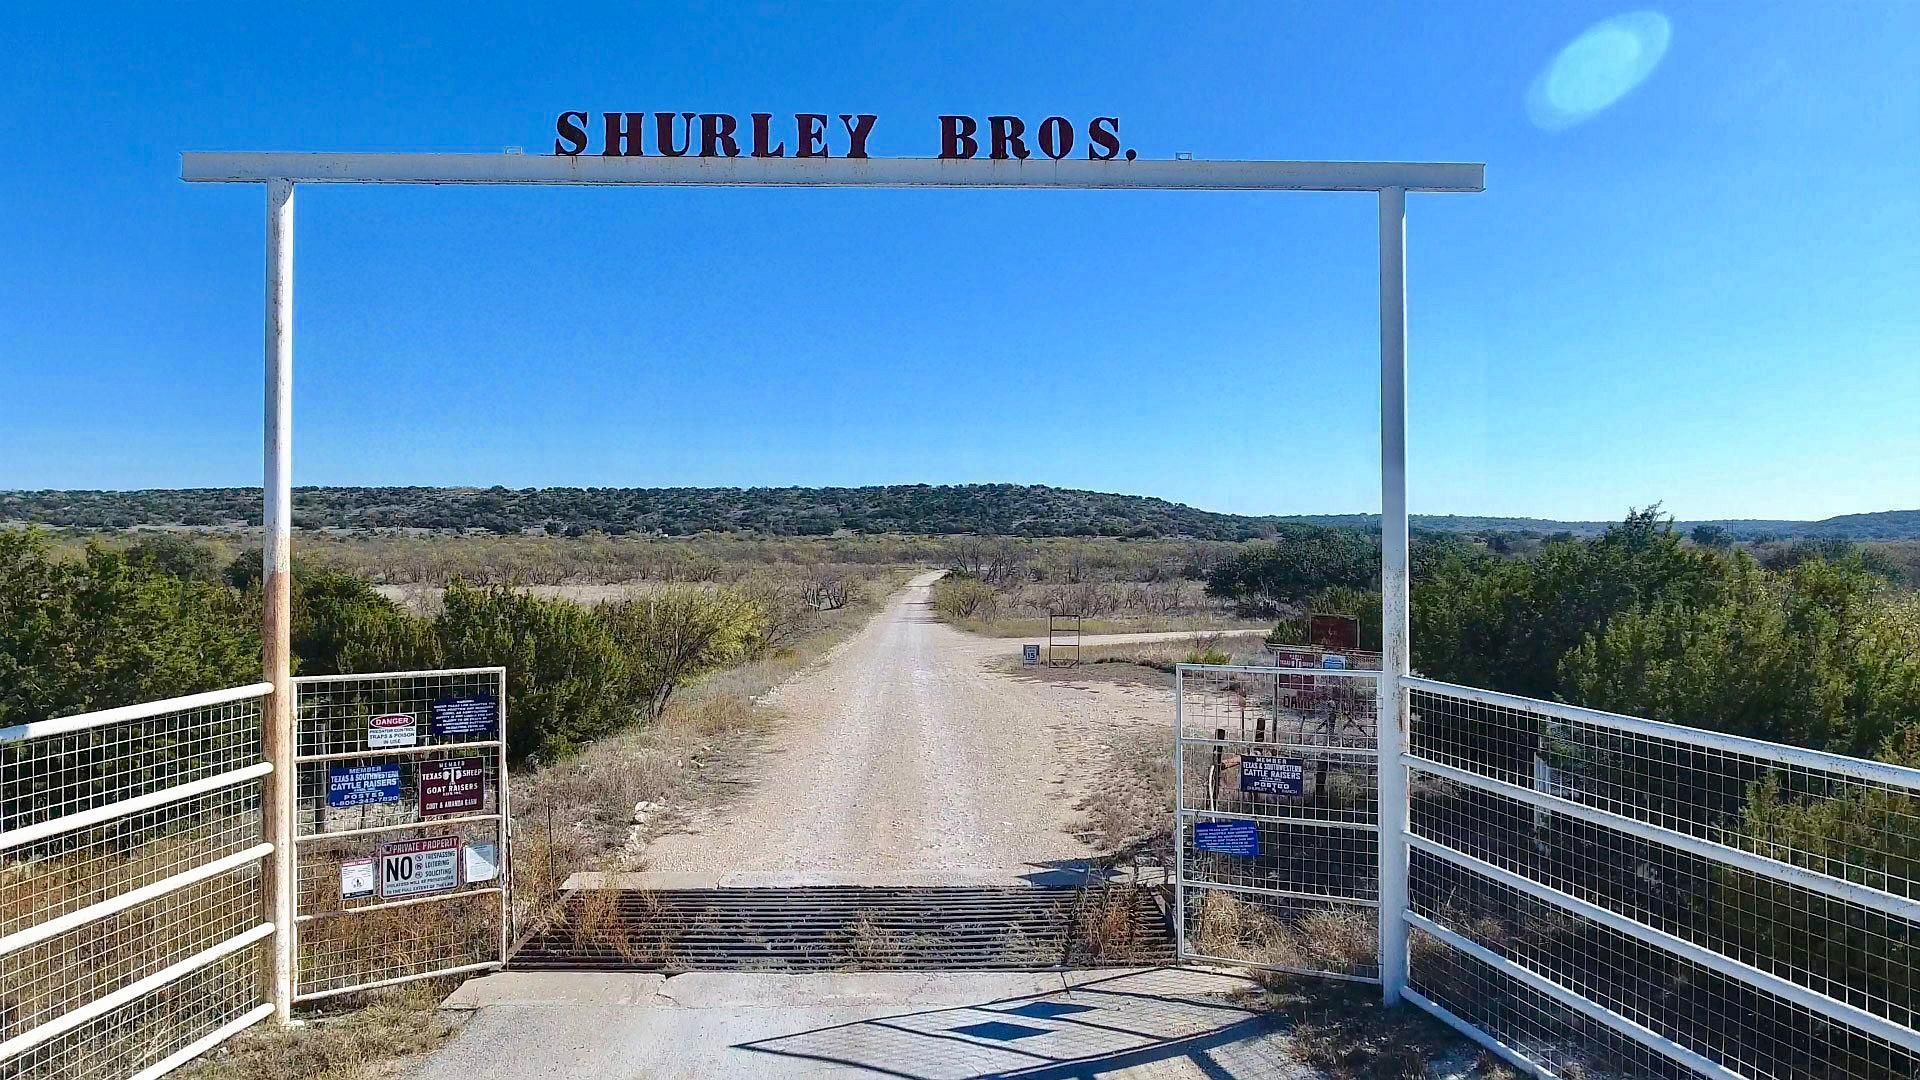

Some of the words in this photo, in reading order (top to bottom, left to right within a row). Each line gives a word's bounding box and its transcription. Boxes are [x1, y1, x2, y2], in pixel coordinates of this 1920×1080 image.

[555, 110, 878, 158] SHURLEY
[938, 115, 1137, 161] BROS.
[375, 717, 409, 726] DANGER
[1242, 761, 1258, 769] TEXAS
[1256, 757, 1287, 765] MEMBER
[349, 766, 382, 774] MEMBER
[422, 772, 442, 780] TEXAS
[462, 769, 482, 777] SHEEP
[1244, 769, 1268, 777] CATTLE
[1270, 770, 1301, 780] RAISERS
[331, 774, 350, 783] TEXAS
[331, 781, 362, 791] CATTLE
[364, 778, 397, 788] RAISERS
[426, 786, 446, 794] GOAT
[449, 783, 478, 792] RAISERS
[1253, 781, 1290, 790] POSTED
[344, 791, 384, 800] POSTED
[393, 842, 420, 854] PRIVATE
[422, 838, 458, 851] PROPERTY
[425, 851, 456, 860] TRESPASSING
[386, 856, 413, 883] NO
[425, 868, 452, 877] SOLICITING
